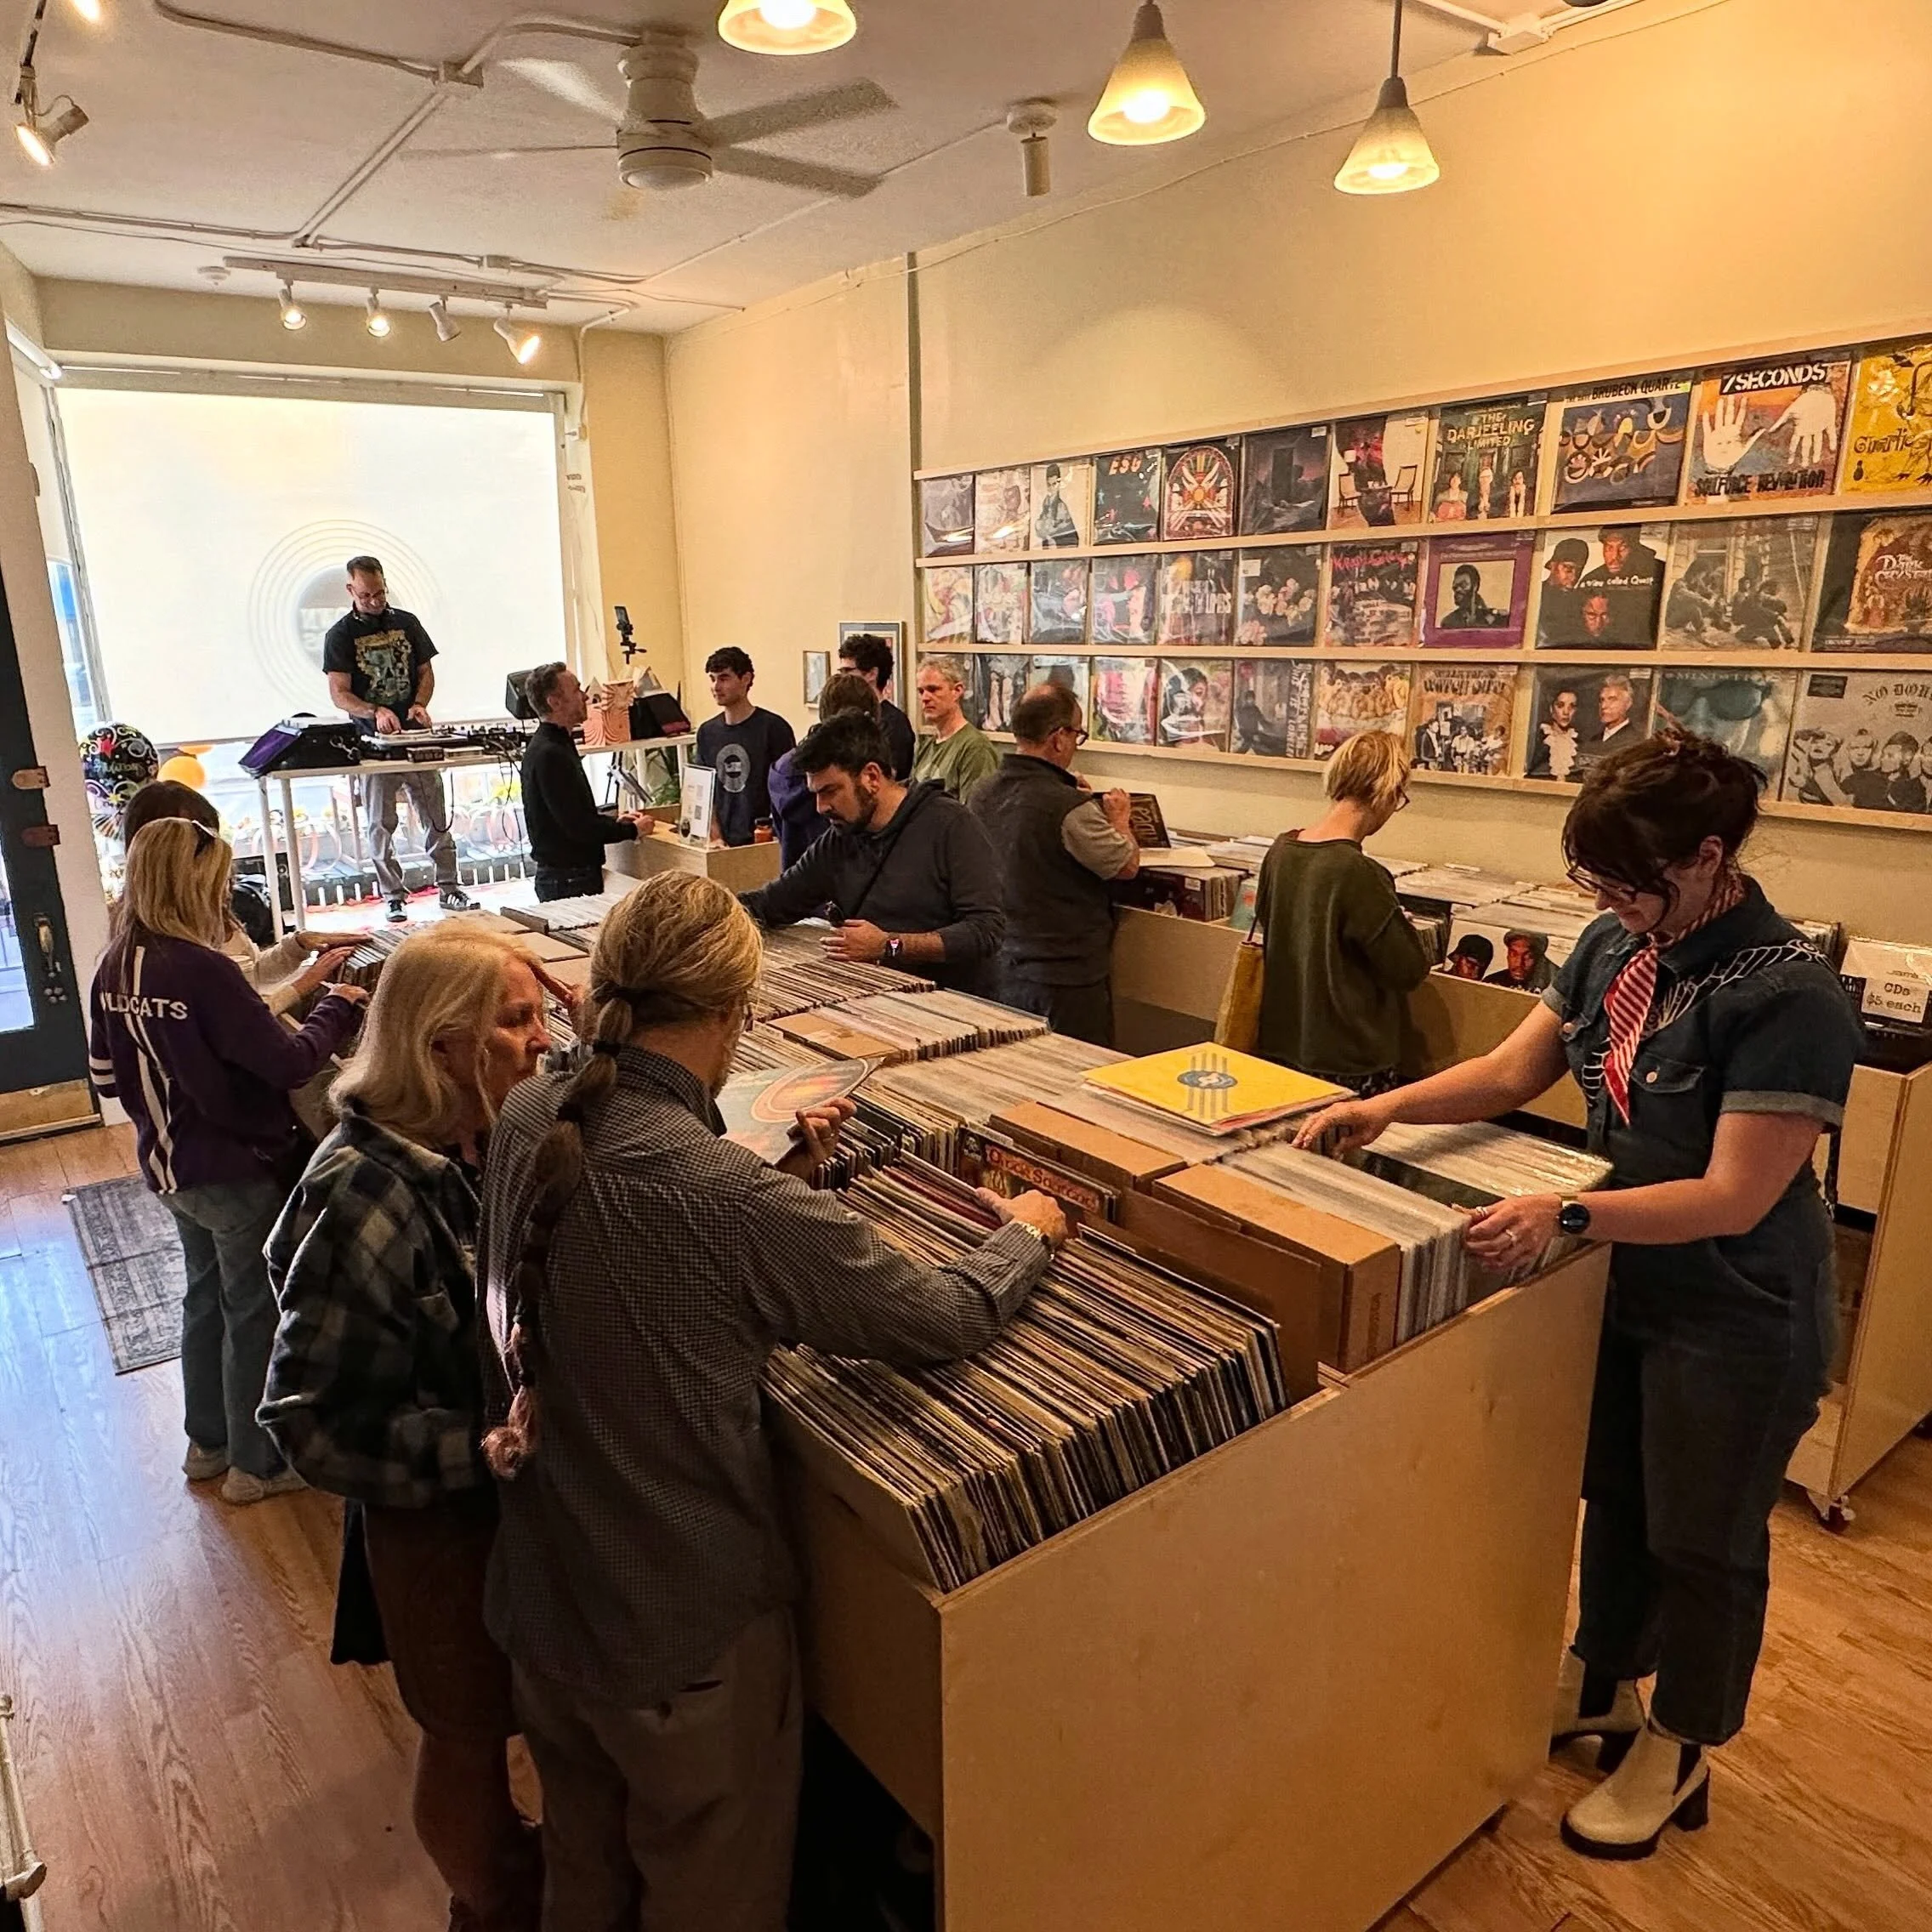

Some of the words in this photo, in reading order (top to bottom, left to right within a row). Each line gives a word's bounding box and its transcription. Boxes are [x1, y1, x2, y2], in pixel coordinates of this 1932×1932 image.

[1591, 383, 1638, 401] BRUBECK
[1481, 412, 1505, 423] THE
[1447, 418, 1535, 443] DARJEELING
[1467, 436, 1511, 450] LIMITED
[1862, 686, 1888, 705] NO
[1894, 684, 1932, 701] DOU
[1884, 982, 1912, 997] CDs
[1867, 993, 1883, 1006] $5
[1886, 1001, 1922, 1014] each
